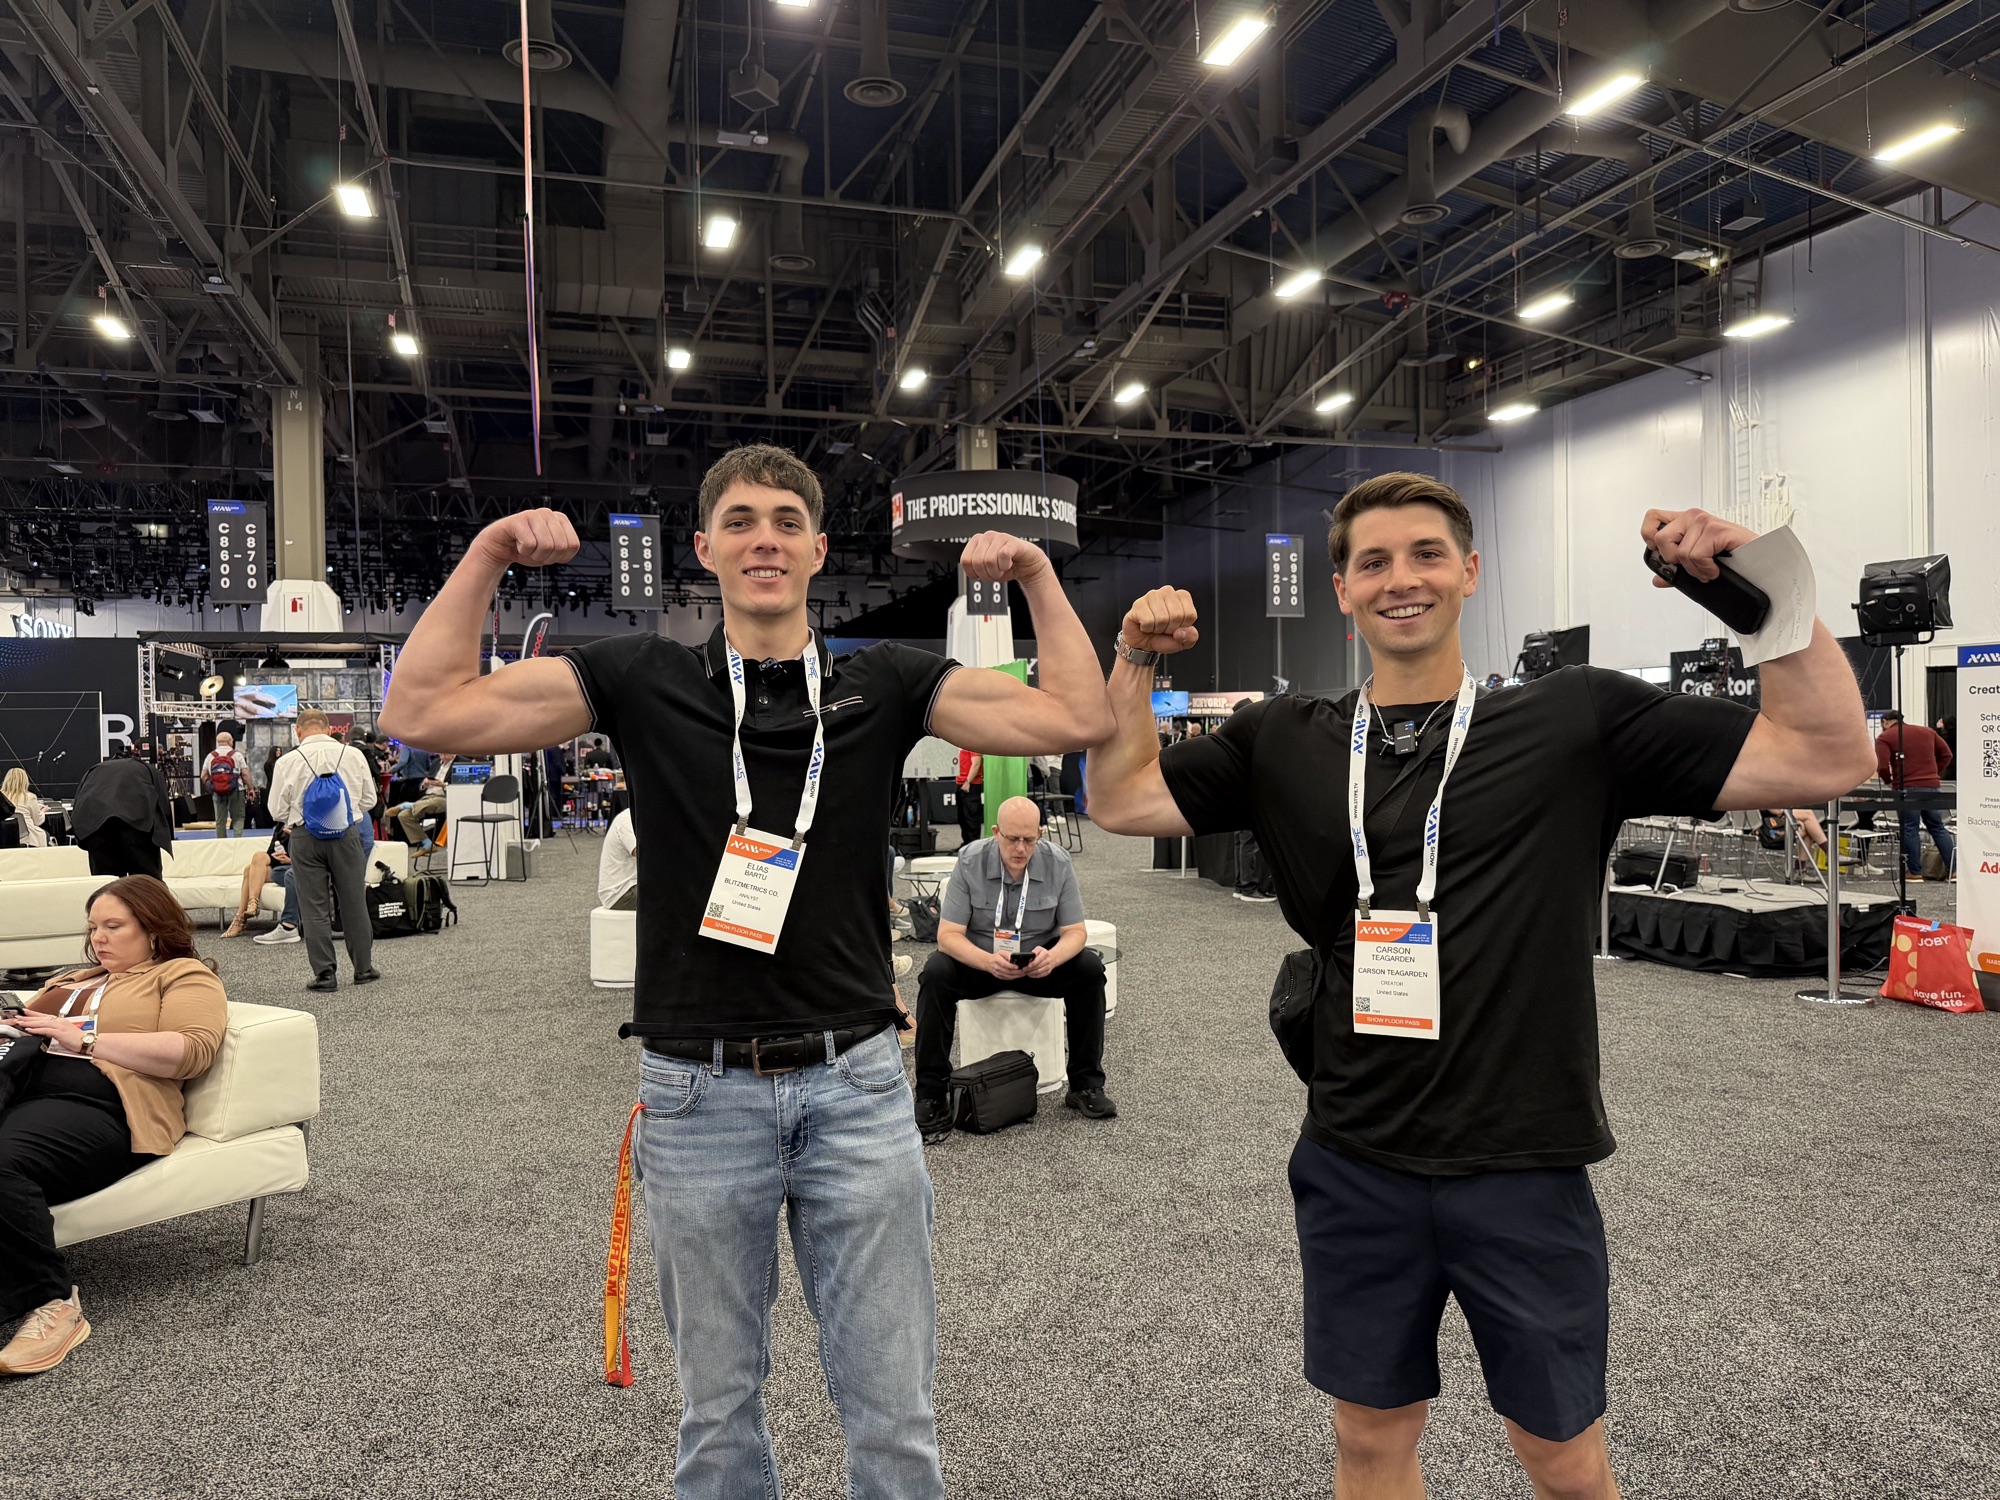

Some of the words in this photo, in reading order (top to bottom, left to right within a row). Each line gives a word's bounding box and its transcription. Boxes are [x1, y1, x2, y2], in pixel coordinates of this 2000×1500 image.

[290, 390, 298, 399] N
[286, 401, 303, 411] 14
[977, 429, 985, 438] N
[975, 439, 988, 448] 15
[906, 497, 928, 522] THE
[929, 492, 1050, 519] PROFESSIONAL'S
[218, 522, 231, 589] C8600
[245, 523, 257, 590] C8700
[618, 534, 631, 597] C8800
[641, 535, 654, 597] C8900
[1272, 551, 1281, 606] C9200
[1289, 552, 1298, 606] C9300
[19, 613, 74, 638] SONY
[1681, 676, 1756, 697] Cretor
[1981, 724, 1995, 734] QR
[730, 840, 760, 854] NAB
[746, 862, 769, 874] ELIAS
[744, 869, 768, 881] BARTU
[724, 877, 768, 895] BLITZMETRICS
[768, 888, 779, 898] CO.
[731, 899, 747, 908] United
[747, 902, 761, 911] States
[714, 922, 731, 931] SHOW
[731, 926, 749, 936] FLOOR
[749, 930, 763, 939] PASS
[1359, 926, 1390, 935] NAB
[1917, 936, 1949, 947] JOBY
[1375, 946, 1411, 955] CARSON
[1371, 954, 1415, 963] TEAGARDEN
[1358, 967, 1385, 976] CARSON
[1386, 969, 1428, 978] TEAGARDEN
[1913, 988, 1939, 1000] Have
[1940, 989, 1966, 999] fun.
[1923, 998, 1967, 1008] Create.
